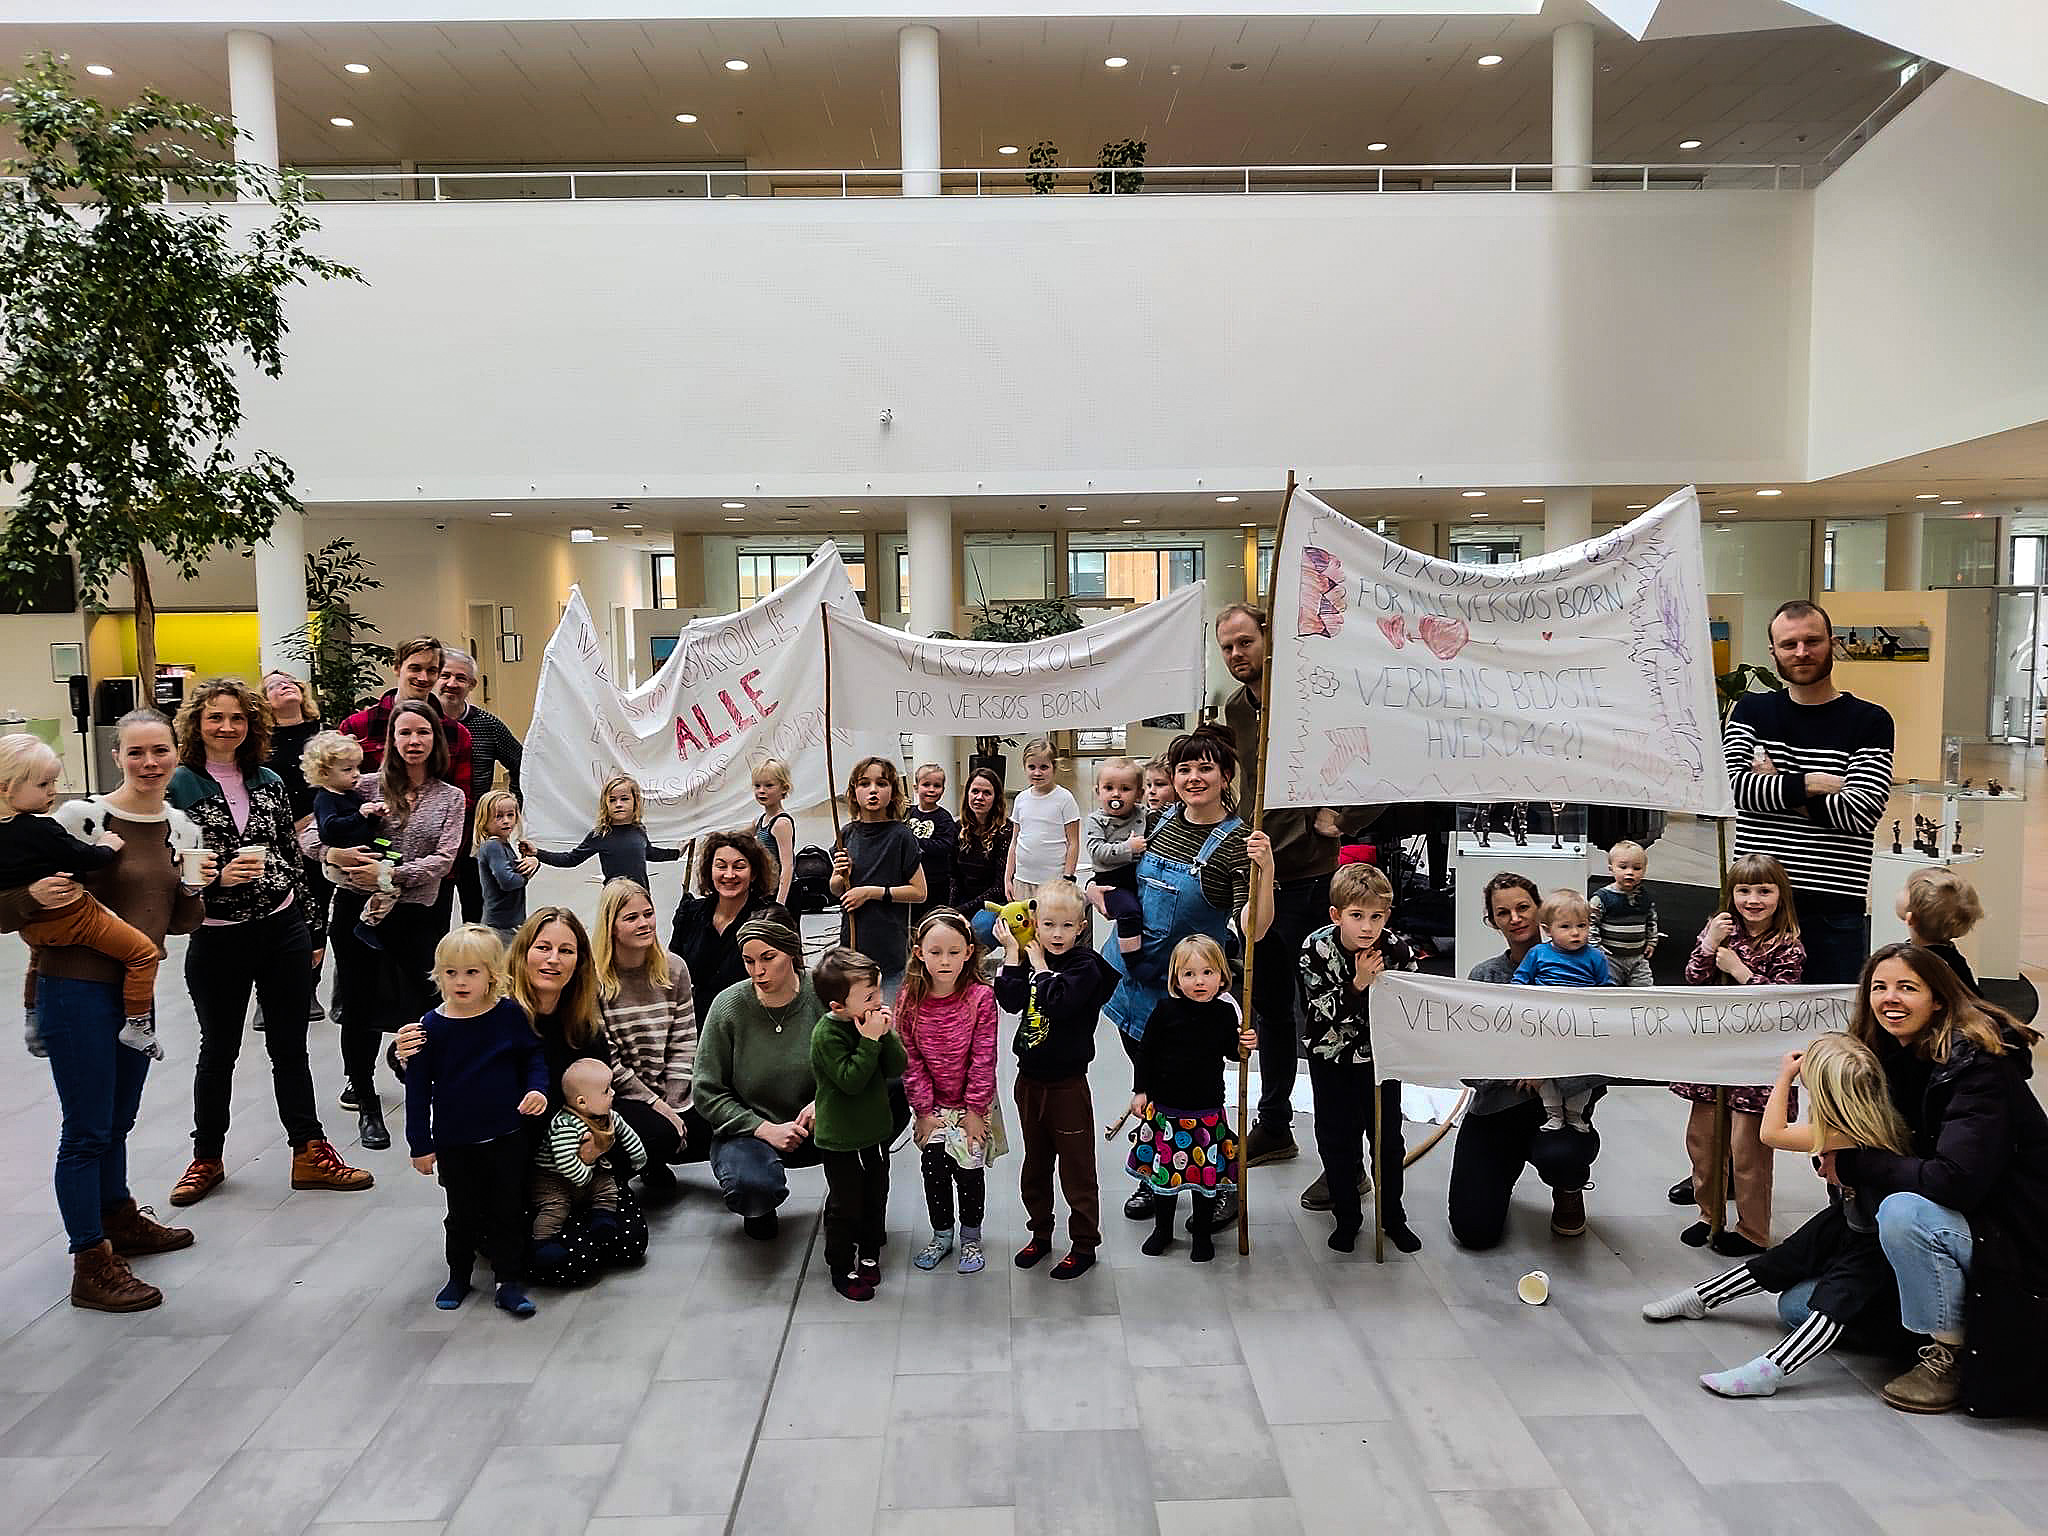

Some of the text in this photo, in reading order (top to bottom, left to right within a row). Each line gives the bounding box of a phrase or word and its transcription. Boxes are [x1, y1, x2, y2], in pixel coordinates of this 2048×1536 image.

[1358, 578, 1404, 613] FOR
[1457, 591, 1551, 623] VEKSØS
[1556, 581, 1624, 619] BØRN
[895, 687, 1101, 719] FOR VEKSØS BØRN
[1354, 667, 1614, 709] VERDENS BEDSTE
[674, 668, 779, 761] ALLE
[1630, 1006, 1672, 1036] FOR
